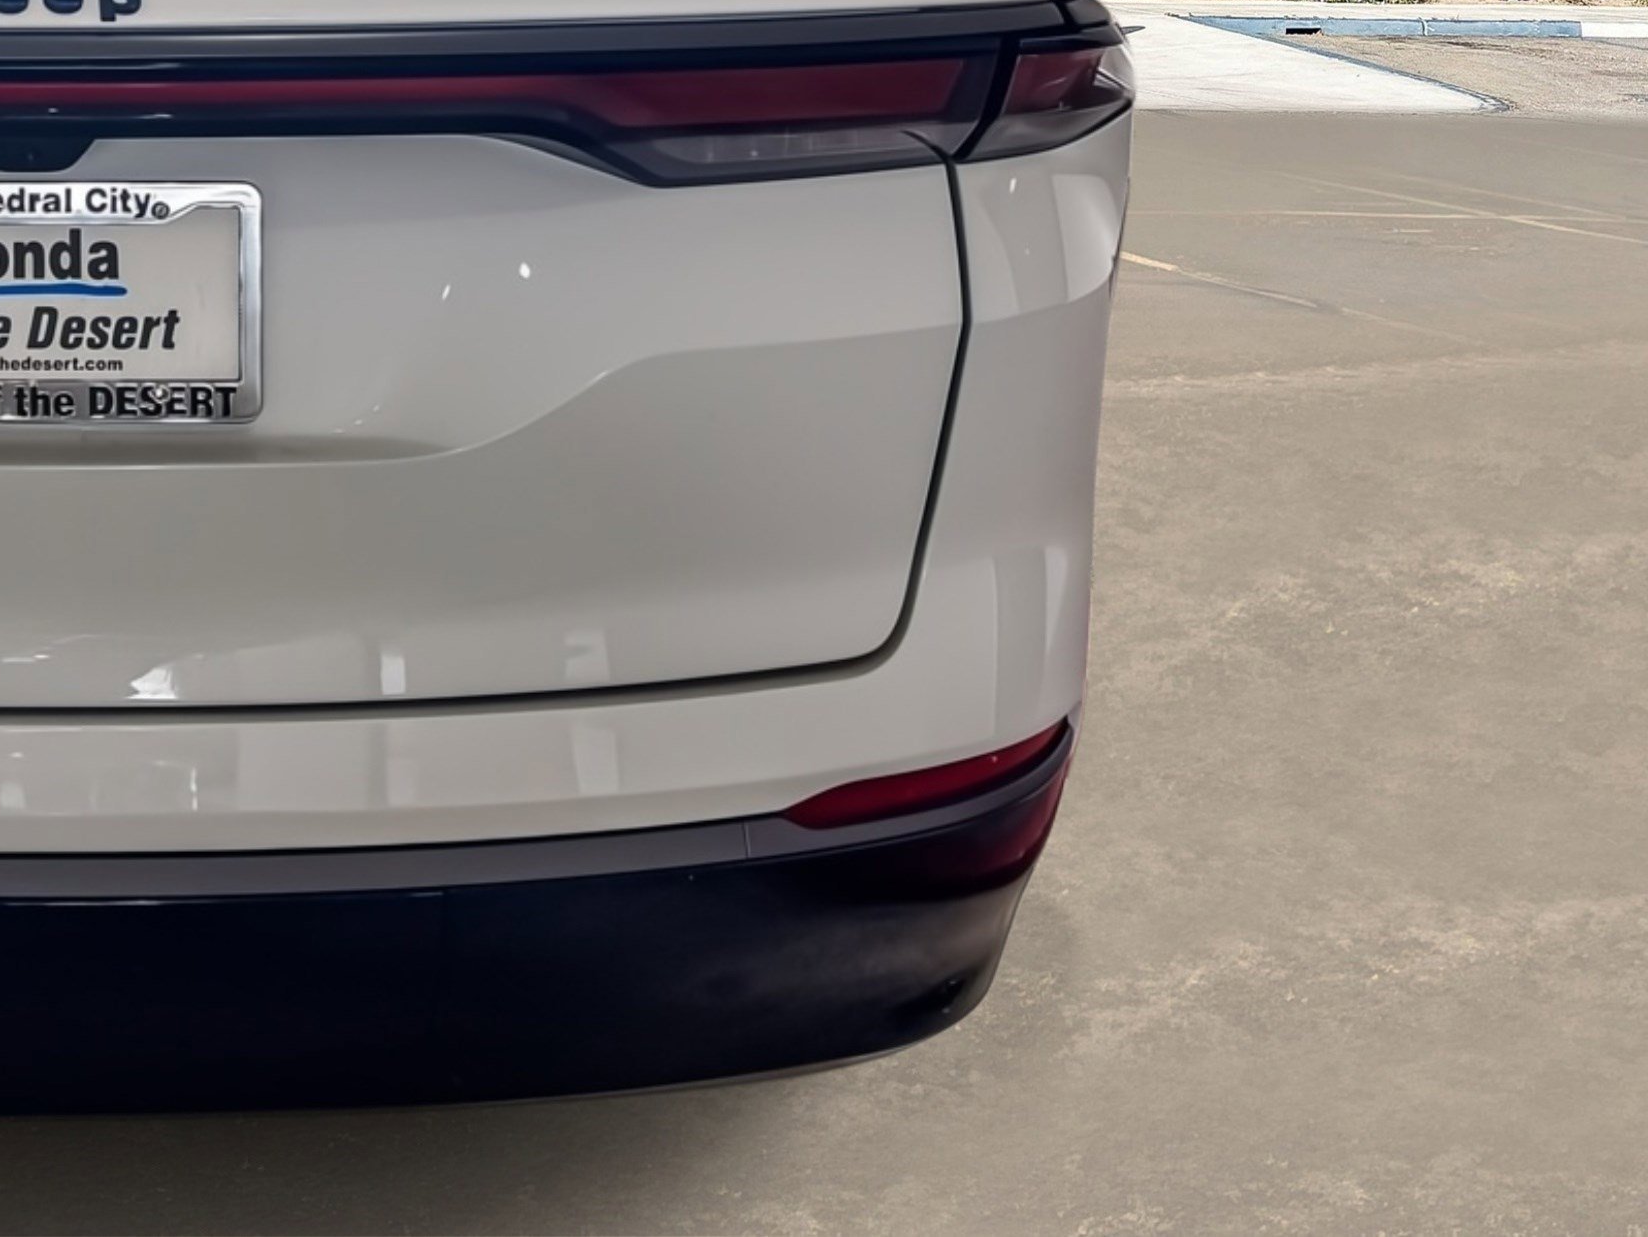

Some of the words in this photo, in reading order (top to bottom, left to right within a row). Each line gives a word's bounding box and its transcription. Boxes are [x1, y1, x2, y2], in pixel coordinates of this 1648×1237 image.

[85, 187, 152, 220] City
[26, 306, 181, 350] Desert
[14, 385, 75, 418] the
[87, 385, 239, 418] DESERT
